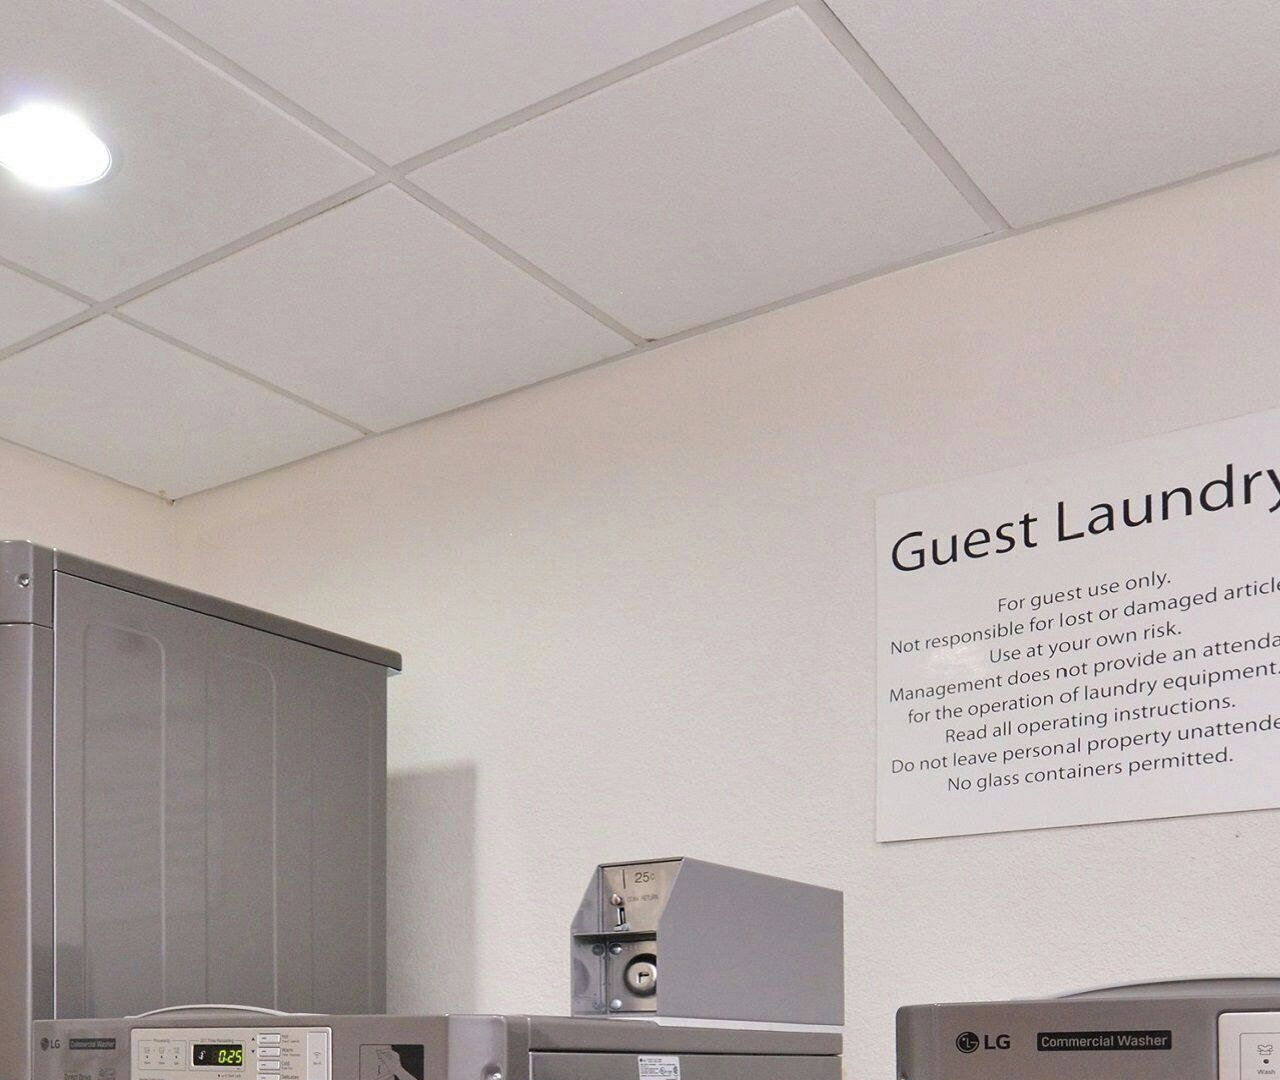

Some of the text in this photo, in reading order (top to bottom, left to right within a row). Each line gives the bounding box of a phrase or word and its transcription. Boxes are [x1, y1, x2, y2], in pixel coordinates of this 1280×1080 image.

[890, 512, 1038, 572] Guest
[997, 570, 1171, 612] For guest use only.
[890, 638, 920, 655] Not
[924, 620, 1024, 649] responsible
[1028, 615, 1055, 632] for
[1059, 610, 1093, 627] lost
[1097, 606, 1118, 621] or
[1122, 586, 1217, 617] damaged
[989, 620, 1181, 663] Use at your own risk.
[889, 674, 1002, 702] Management
[1006, 668, 1050, 686] does
[1055, 662, 1088, 679] not
[1093, 649, 1166, 677] provide
[1172, 647, 1196, 662] an
[907, 708, 931, 723] for
[934, 704, 963, 720] the
[967, 693, 1054, 718] operation
[1059, 685, 1080, 703] of
[1084, 677, 1158, 700] laundry
[945, 696, 1235, 743] Read all operating instructions.
[891, 758, 914, 774] Do
[919, 755, 948, 770] not
[952, 751, 997, 767] leave
[1002, 736, 1081, 764] personal
[1087, 729, 1171, 755] property
[947, 745, 1233, 792] No glass containers permitted.
[50, 1040, 61, 1049] LG
[984, 1034, 1011, 1050] LG
[1042, 1034, 1167, 1048] Commercial Washer
